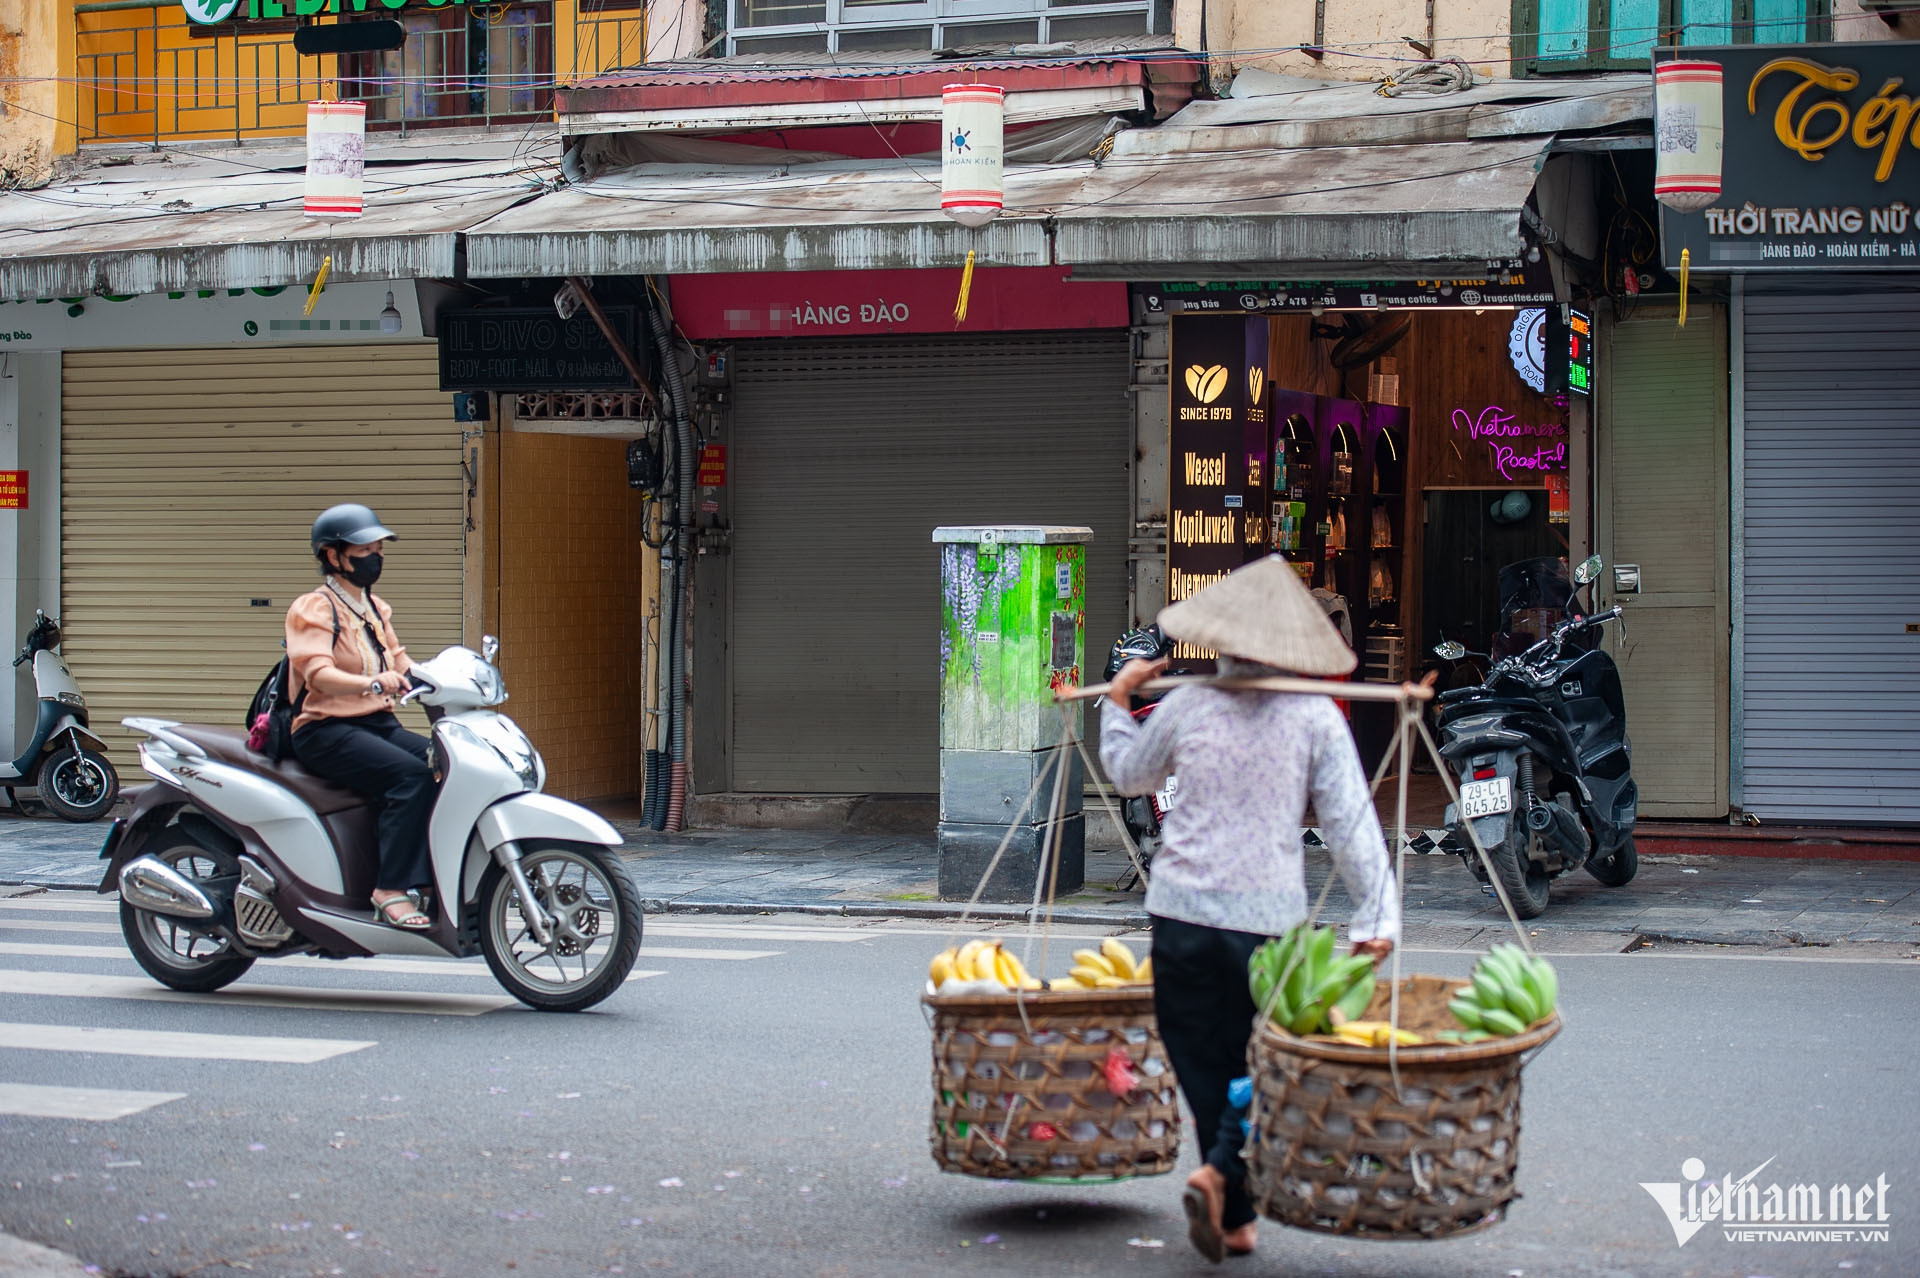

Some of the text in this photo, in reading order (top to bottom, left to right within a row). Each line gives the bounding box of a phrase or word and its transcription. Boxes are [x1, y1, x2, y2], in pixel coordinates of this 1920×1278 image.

[1705, 200, 1767, 235] THỜI
[1771, 208, 1863, 235] TRANG
[1869, 203, 1910, 234] NỮ
[1793, 241, 1815, 258] ĐÀO
[1827, 241, 1857, 257] HOÀN
[1861, 238, 1889, 257] KIẾM
[1901, 239, 1915, 256] HÀ
[859, 298, 909, 323] ĐÀO
[1289, 298, 1307, 306] 478
[1180, 407, 1232, 420] SINCE 1979
[1184, 452, 1226, 486] Weasel
[1174, 509, 1235, 547] KopiLuwak
[1468, 781, 1502, 800] 29-C1
[1465, 795, 1507, 816] 845.25
